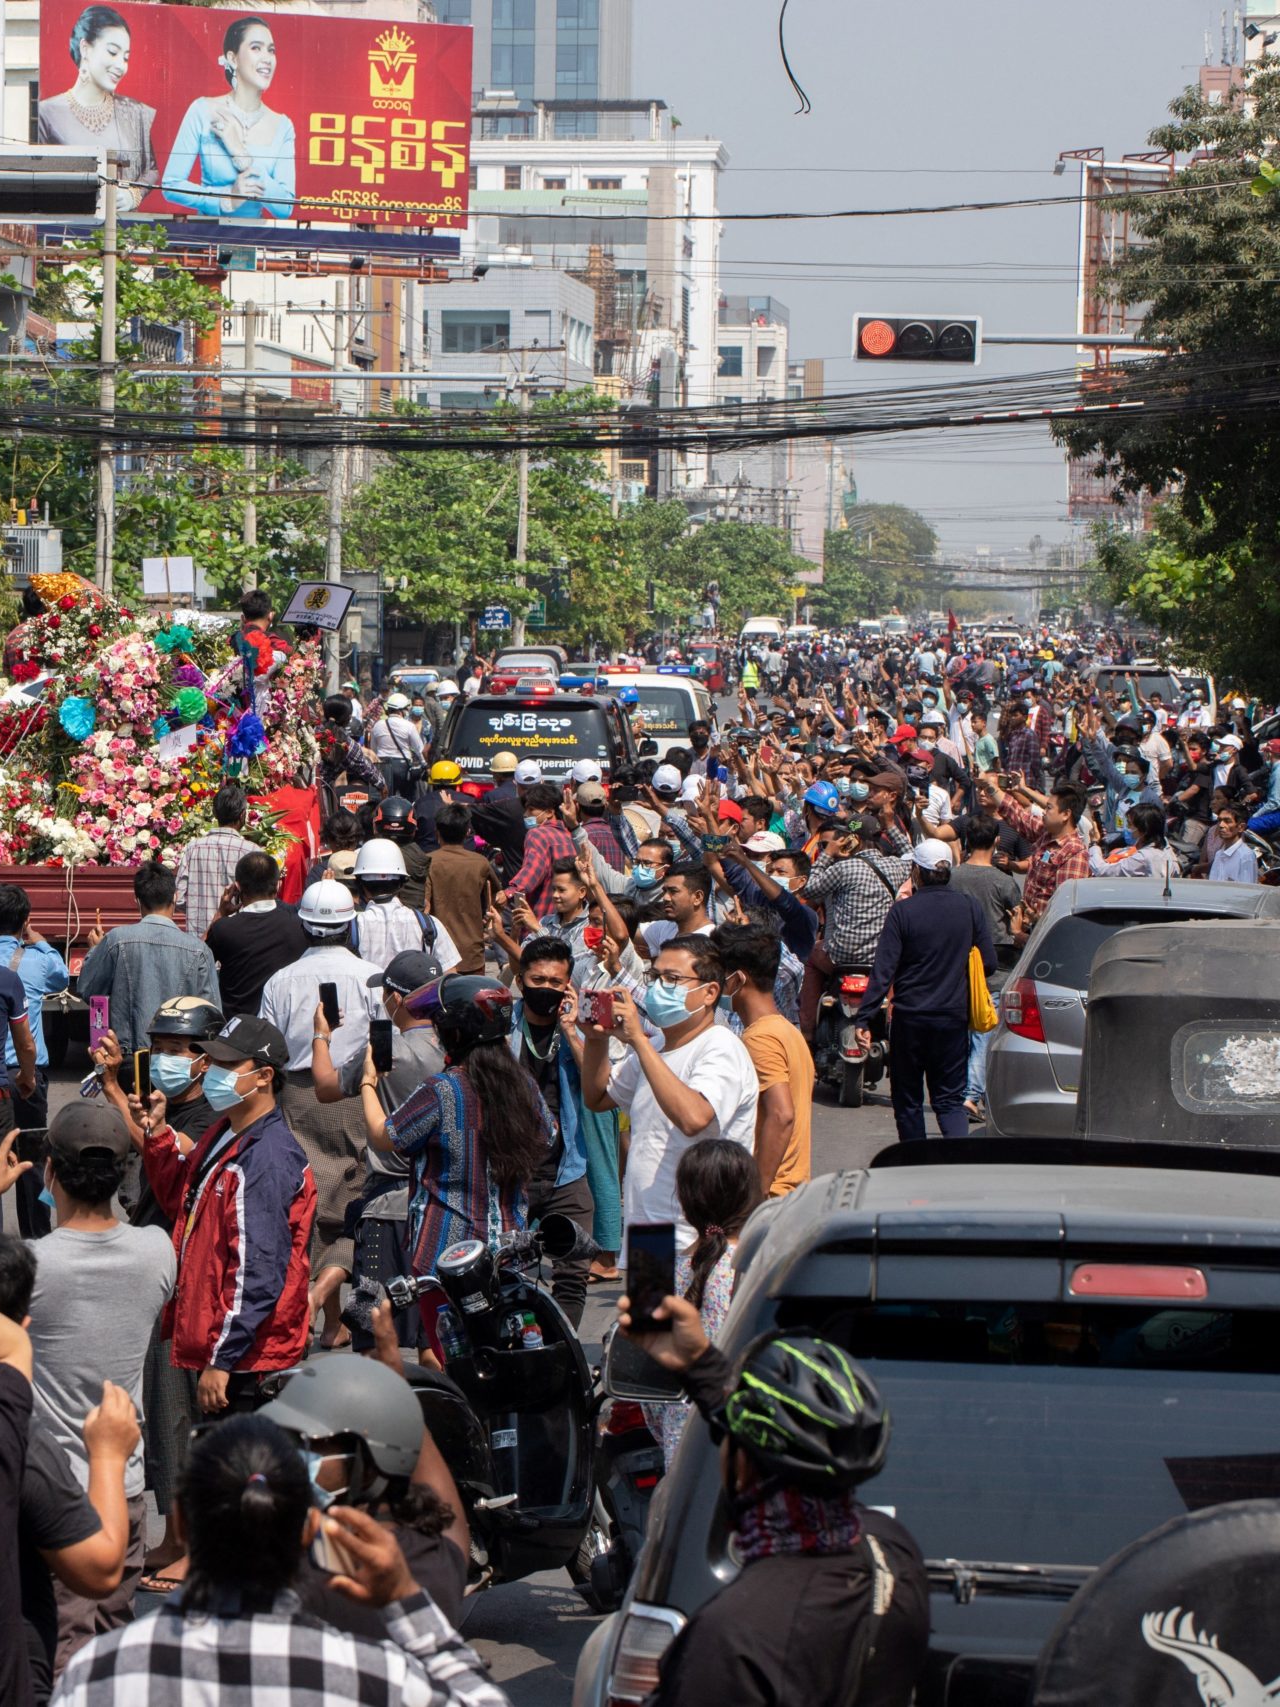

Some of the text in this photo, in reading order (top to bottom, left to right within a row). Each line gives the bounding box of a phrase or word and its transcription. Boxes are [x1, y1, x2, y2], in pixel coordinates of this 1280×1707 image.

[373, 99, 411, 116] ထာဝရ
[455, 757, 483, 769] COVID
[536, 758, 578, 770] Operatio
